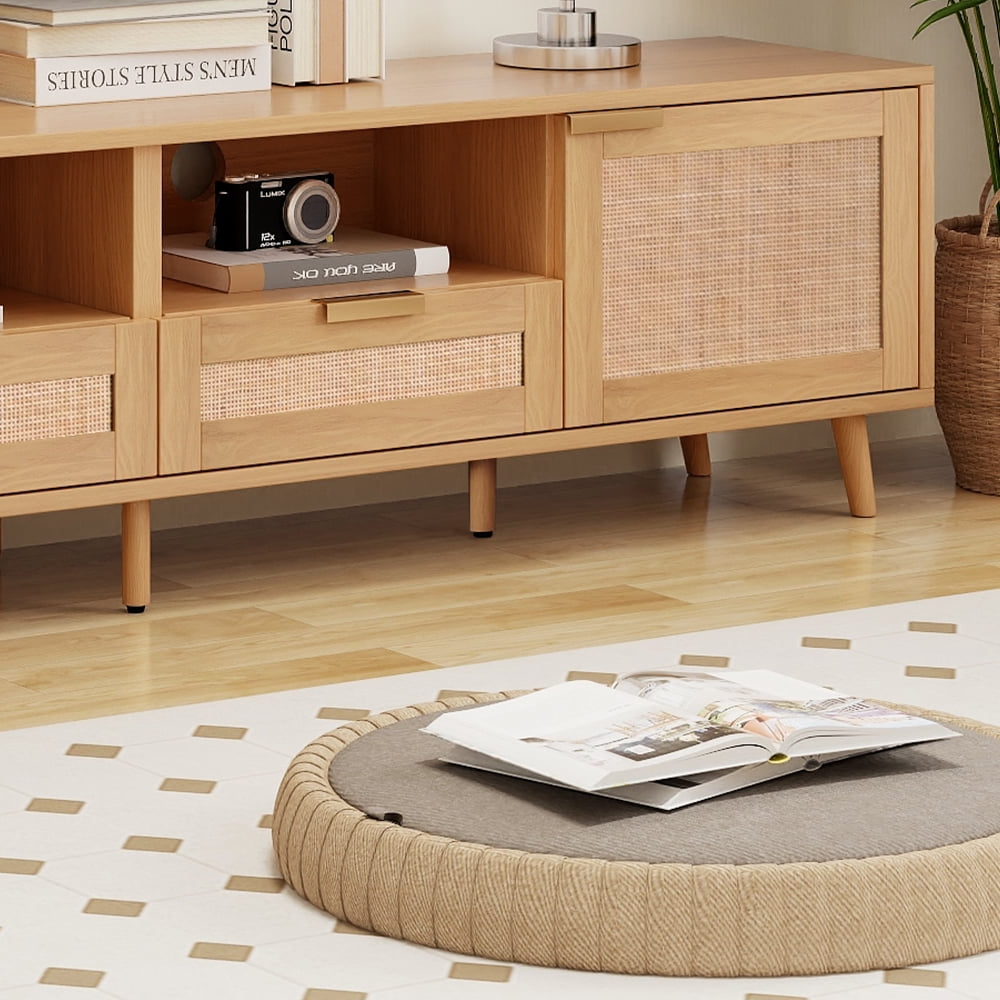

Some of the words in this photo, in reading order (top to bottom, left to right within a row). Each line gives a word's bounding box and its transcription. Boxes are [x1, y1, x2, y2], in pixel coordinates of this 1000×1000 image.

[135, 62, 195, 85] STYLE
[199, 57, 257, 81] MEN'S
[47, 66, 130, 91] STORIES
[260, 190, 286, 198] LUMIX
[292, 268, 319, 280] OK
[361, 262, 396, 274] ARE
